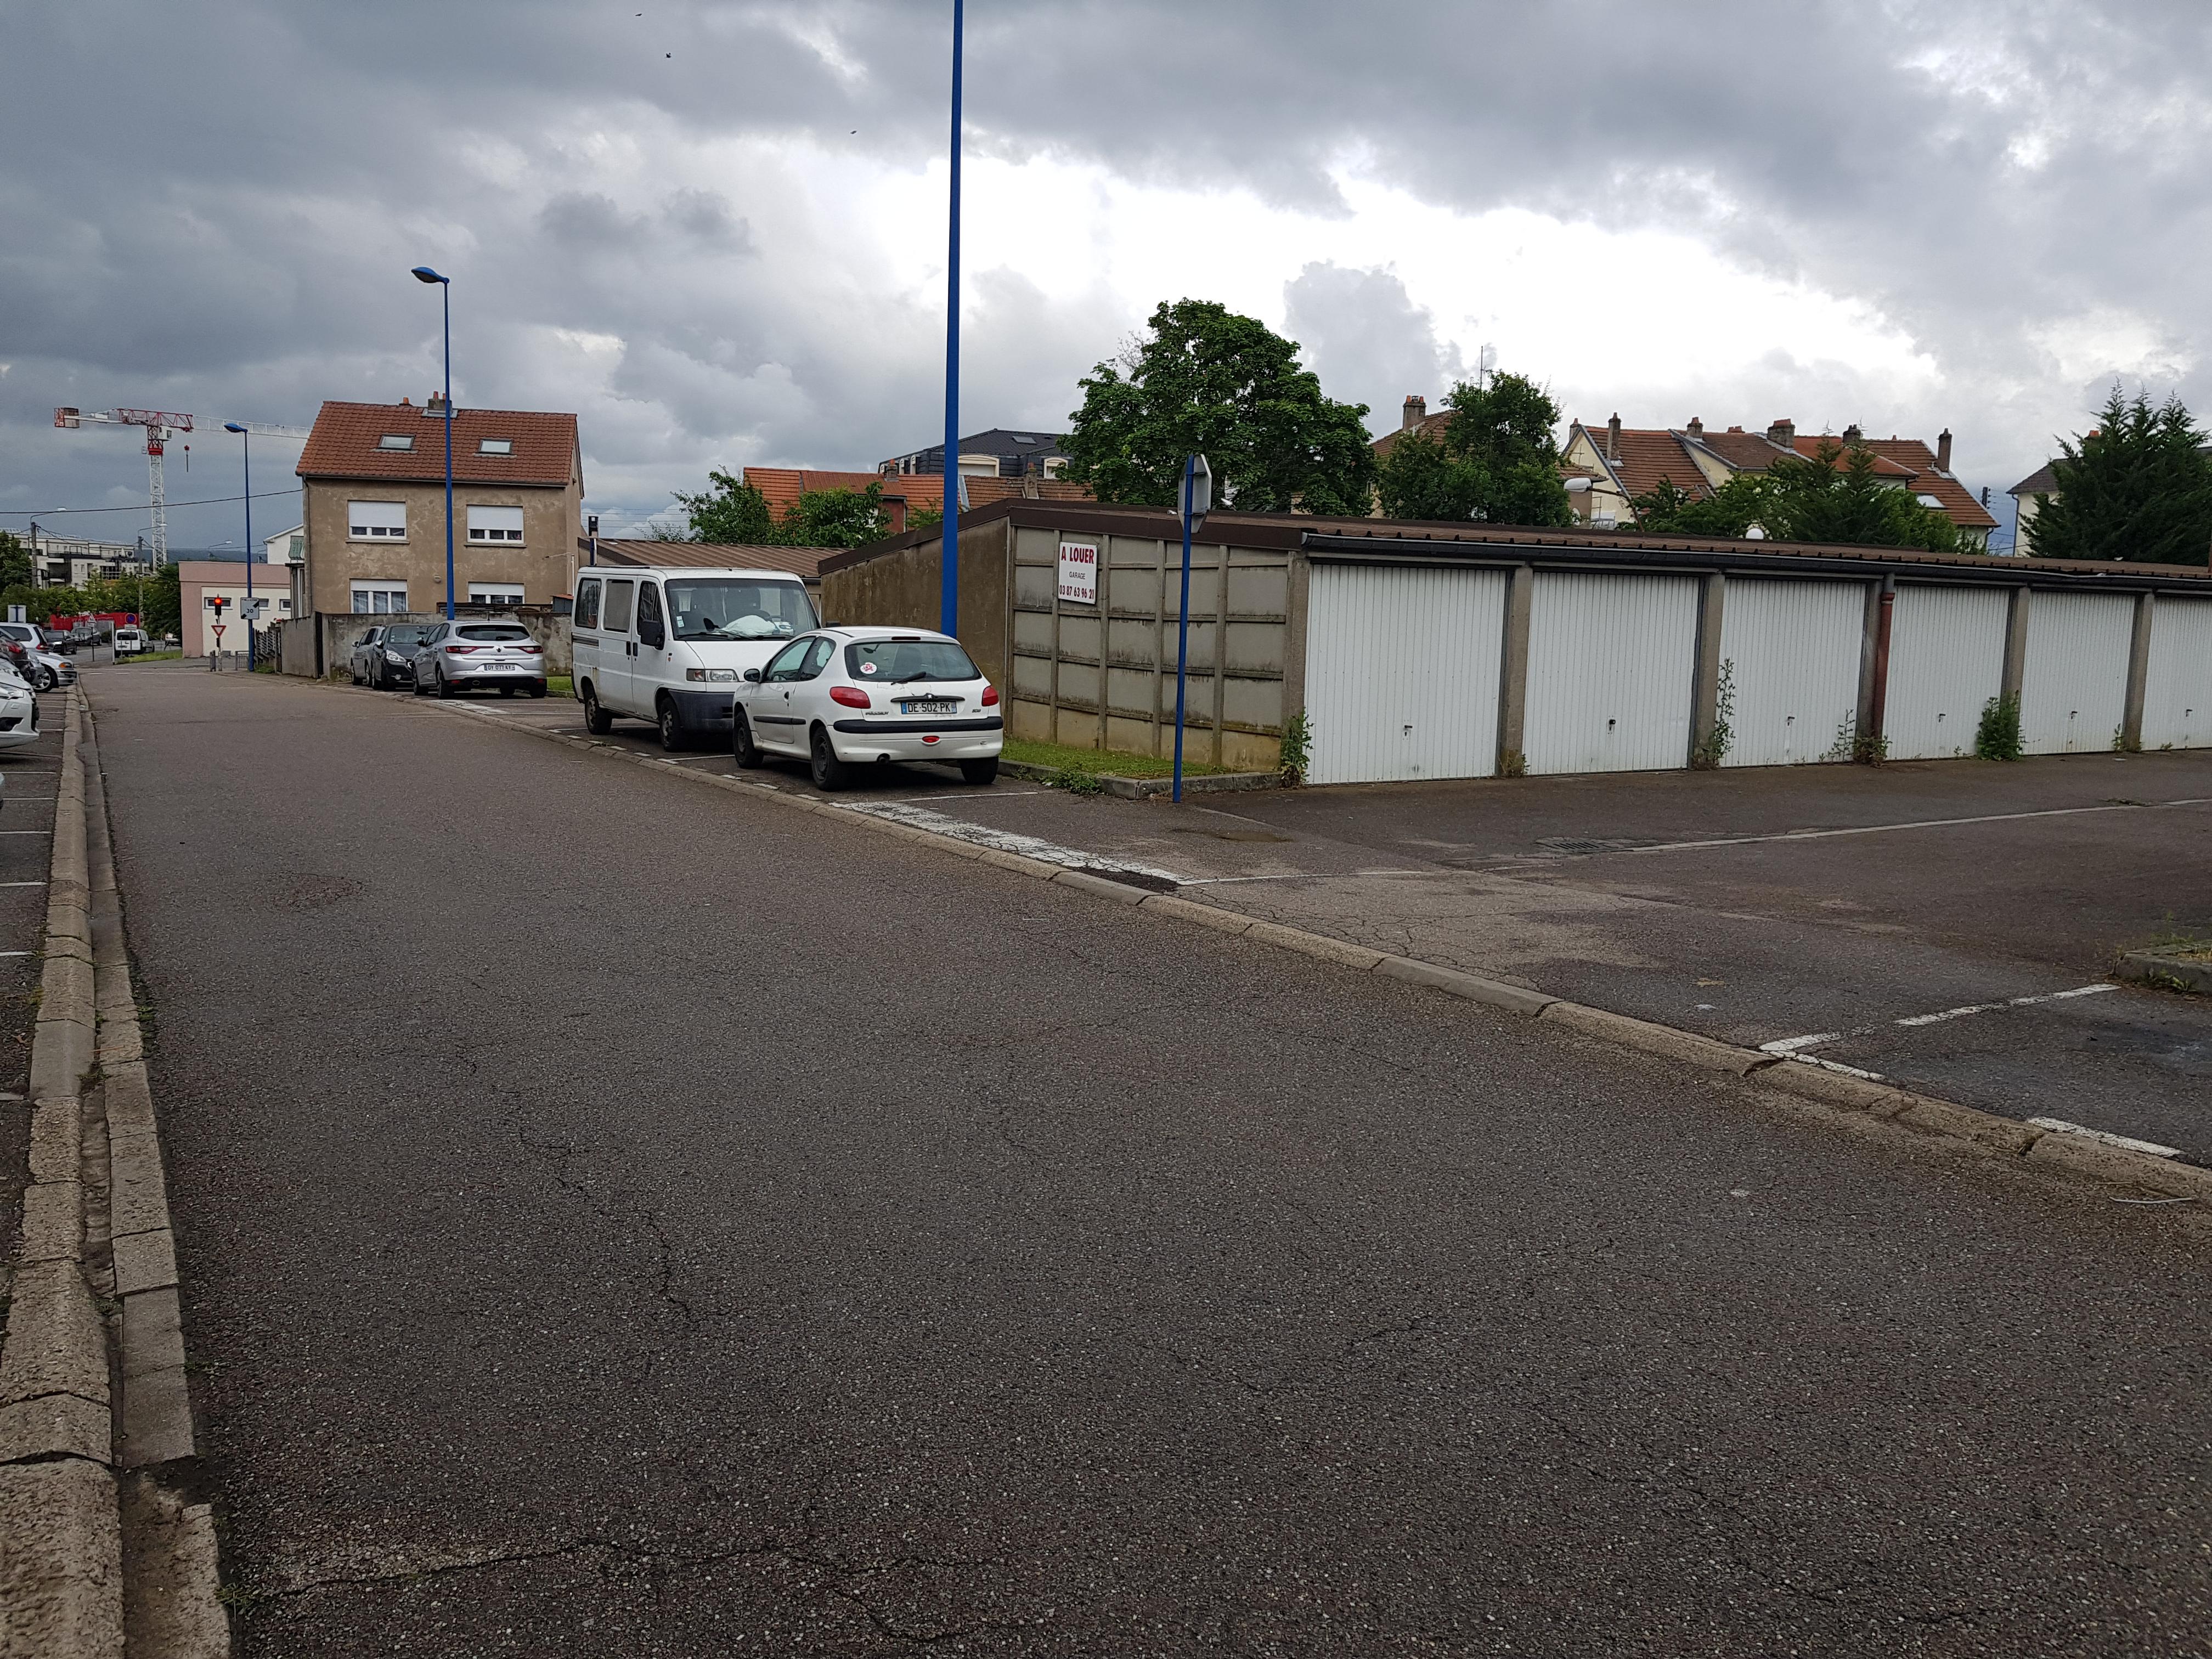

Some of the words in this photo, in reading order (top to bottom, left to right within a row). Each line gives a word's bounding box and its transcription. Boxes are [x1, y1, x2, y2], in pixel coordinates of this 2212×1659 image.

[1061, 546, 1066, 561] A
[1069, 547, 1094, 564] LOUER
[1059, 585, 1065, 595] 03
[1066, 585, 1072, 596] 87
[1074, 587, 1080, 597] 63
[1081, 588, 1087, 598] 96
[1089, 589, 1094, 599] 21
